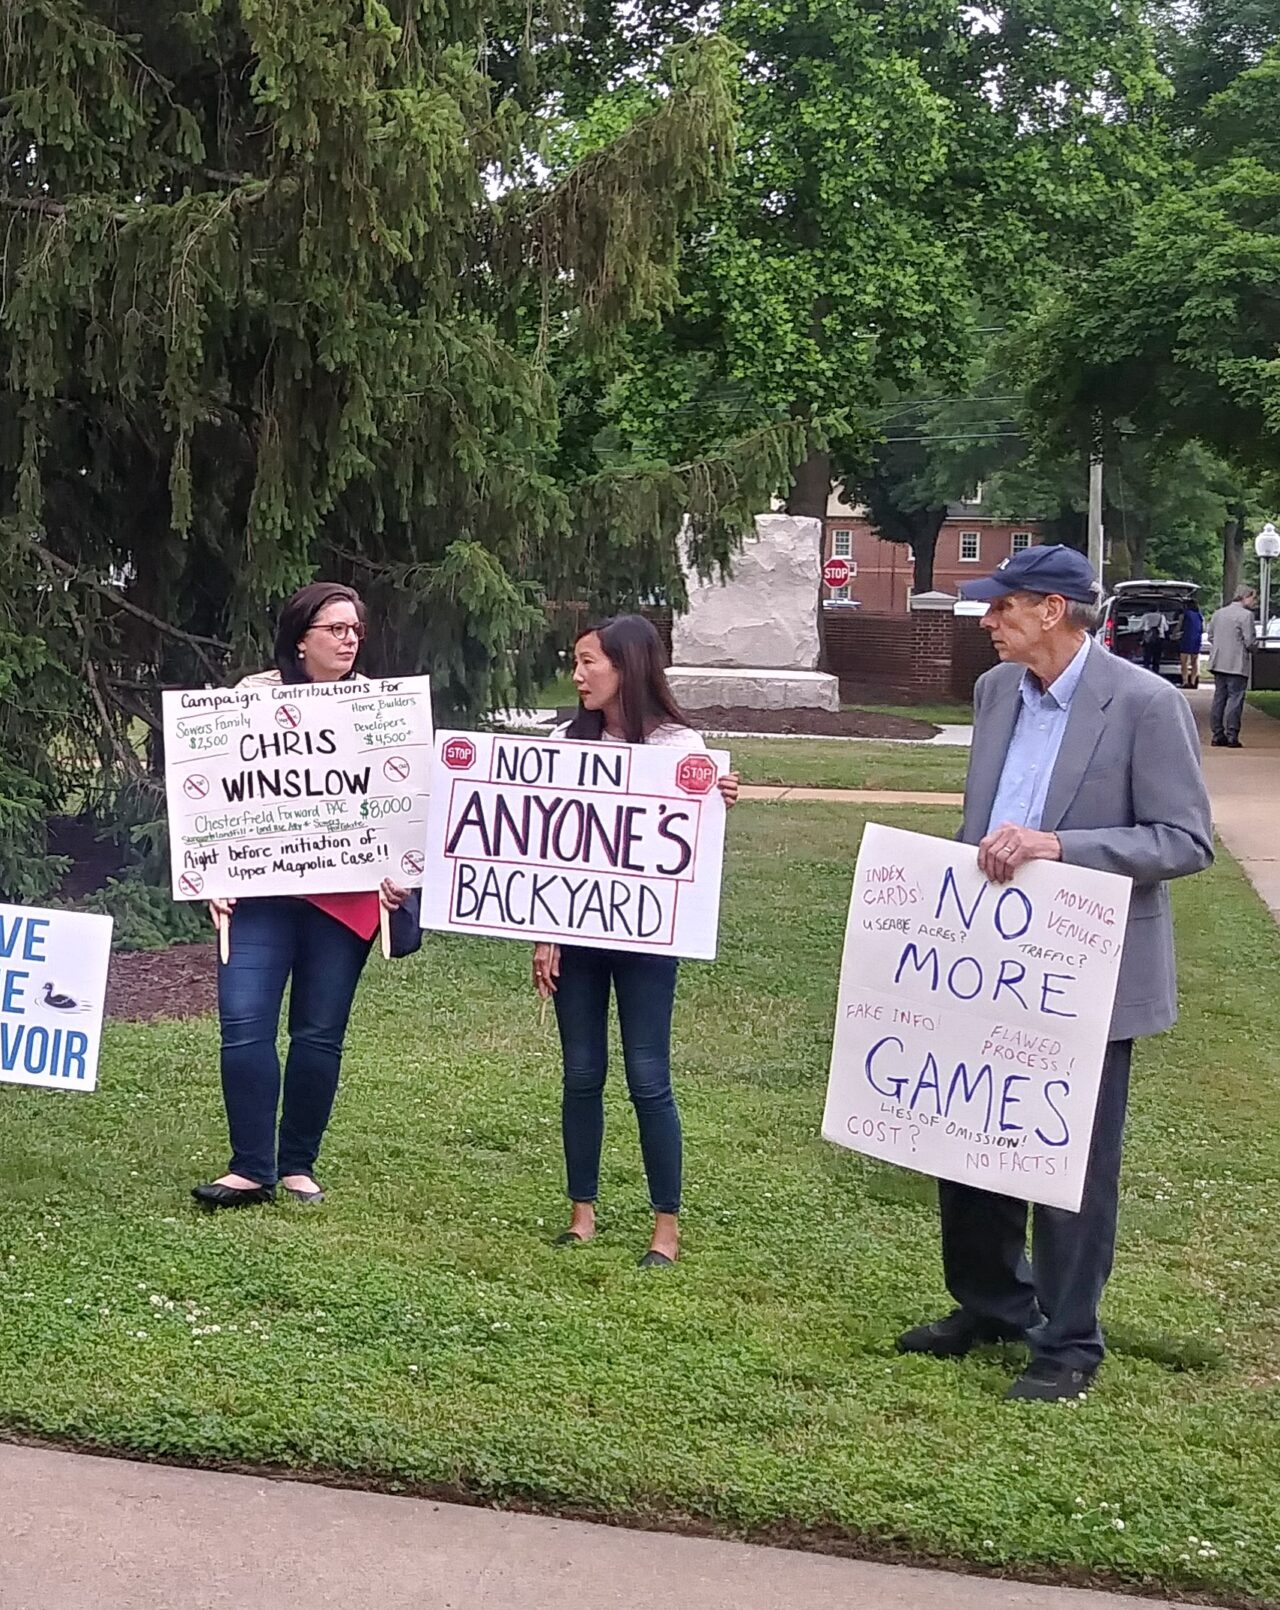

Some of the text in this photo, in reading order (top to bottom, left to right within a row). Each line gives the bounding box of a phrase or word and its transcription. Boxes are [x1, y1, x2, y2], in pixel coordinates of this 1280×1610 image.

[824, 568, 848, 578] STOP
[181, 680, 404, 710] Campaign Contributions for
[216, 712, 250, 730] Family
[354, 718, 406, 732] Developers
[189, 734, 228, 750] $2,500
[240, 729, 337, 762] CHRIS
[447, 748, 472, 760] STOP
[496, 746, 622, 786] NOT IN
[682, 768, 712, 782] STOP
[222, 767, 371, 802] WINSLOW
[194, 796, 412, 833] Chesterfield Forward PAC $8,000
[184, 828, 376, 871] Right before initiation of
[446, 790, 692, 876] ANYONE'S
[228, 844, 389, 880] Upper Magnolia Case!!
[866, 865, 906, 883] INDEX
[456, 864, 662, 938] BACKYARD
[863, 881, 924, 906] CARDS!
[934, 867, 1032, 940] NO
[1054, 888, 1115, 926] MOVING
[894, 943, 1078, 1018] MORE
[846, 1003, 884, 1020] FAKE
[990, 1025, 1062, 1056] FLAWED
[864, 1036, 1070, 1148] GAMES
[880, 1102, 1028, 1149] LIES OF OMISSION!
[966, 1152, 990, 1169] NO
